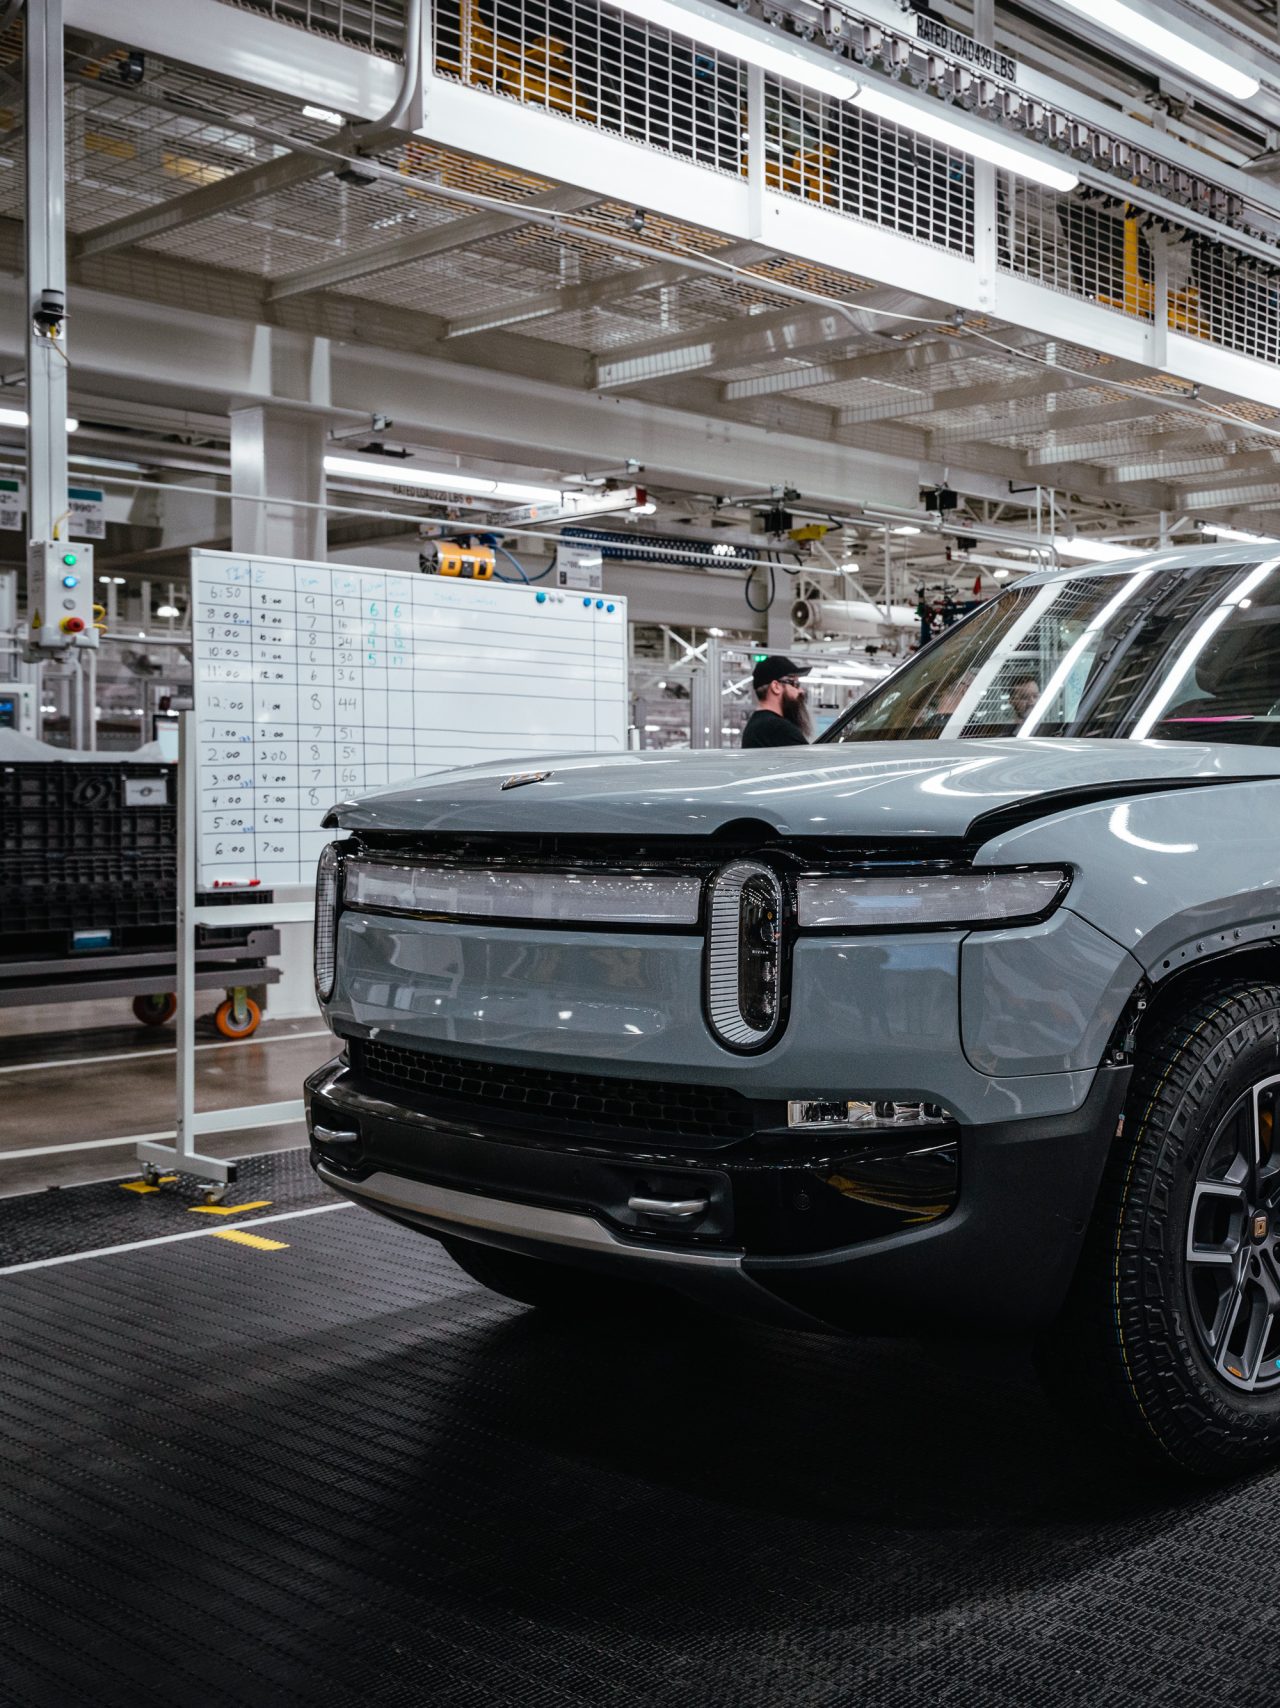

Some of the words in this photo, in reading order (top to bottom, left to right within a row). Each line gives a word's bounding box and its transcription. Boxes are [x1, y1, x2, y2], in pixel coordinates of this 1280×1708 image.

[917, 14, 948, 49] RATED
[950, 31, 974, 61] LOAD
[974, 43, 992, 70] 430
